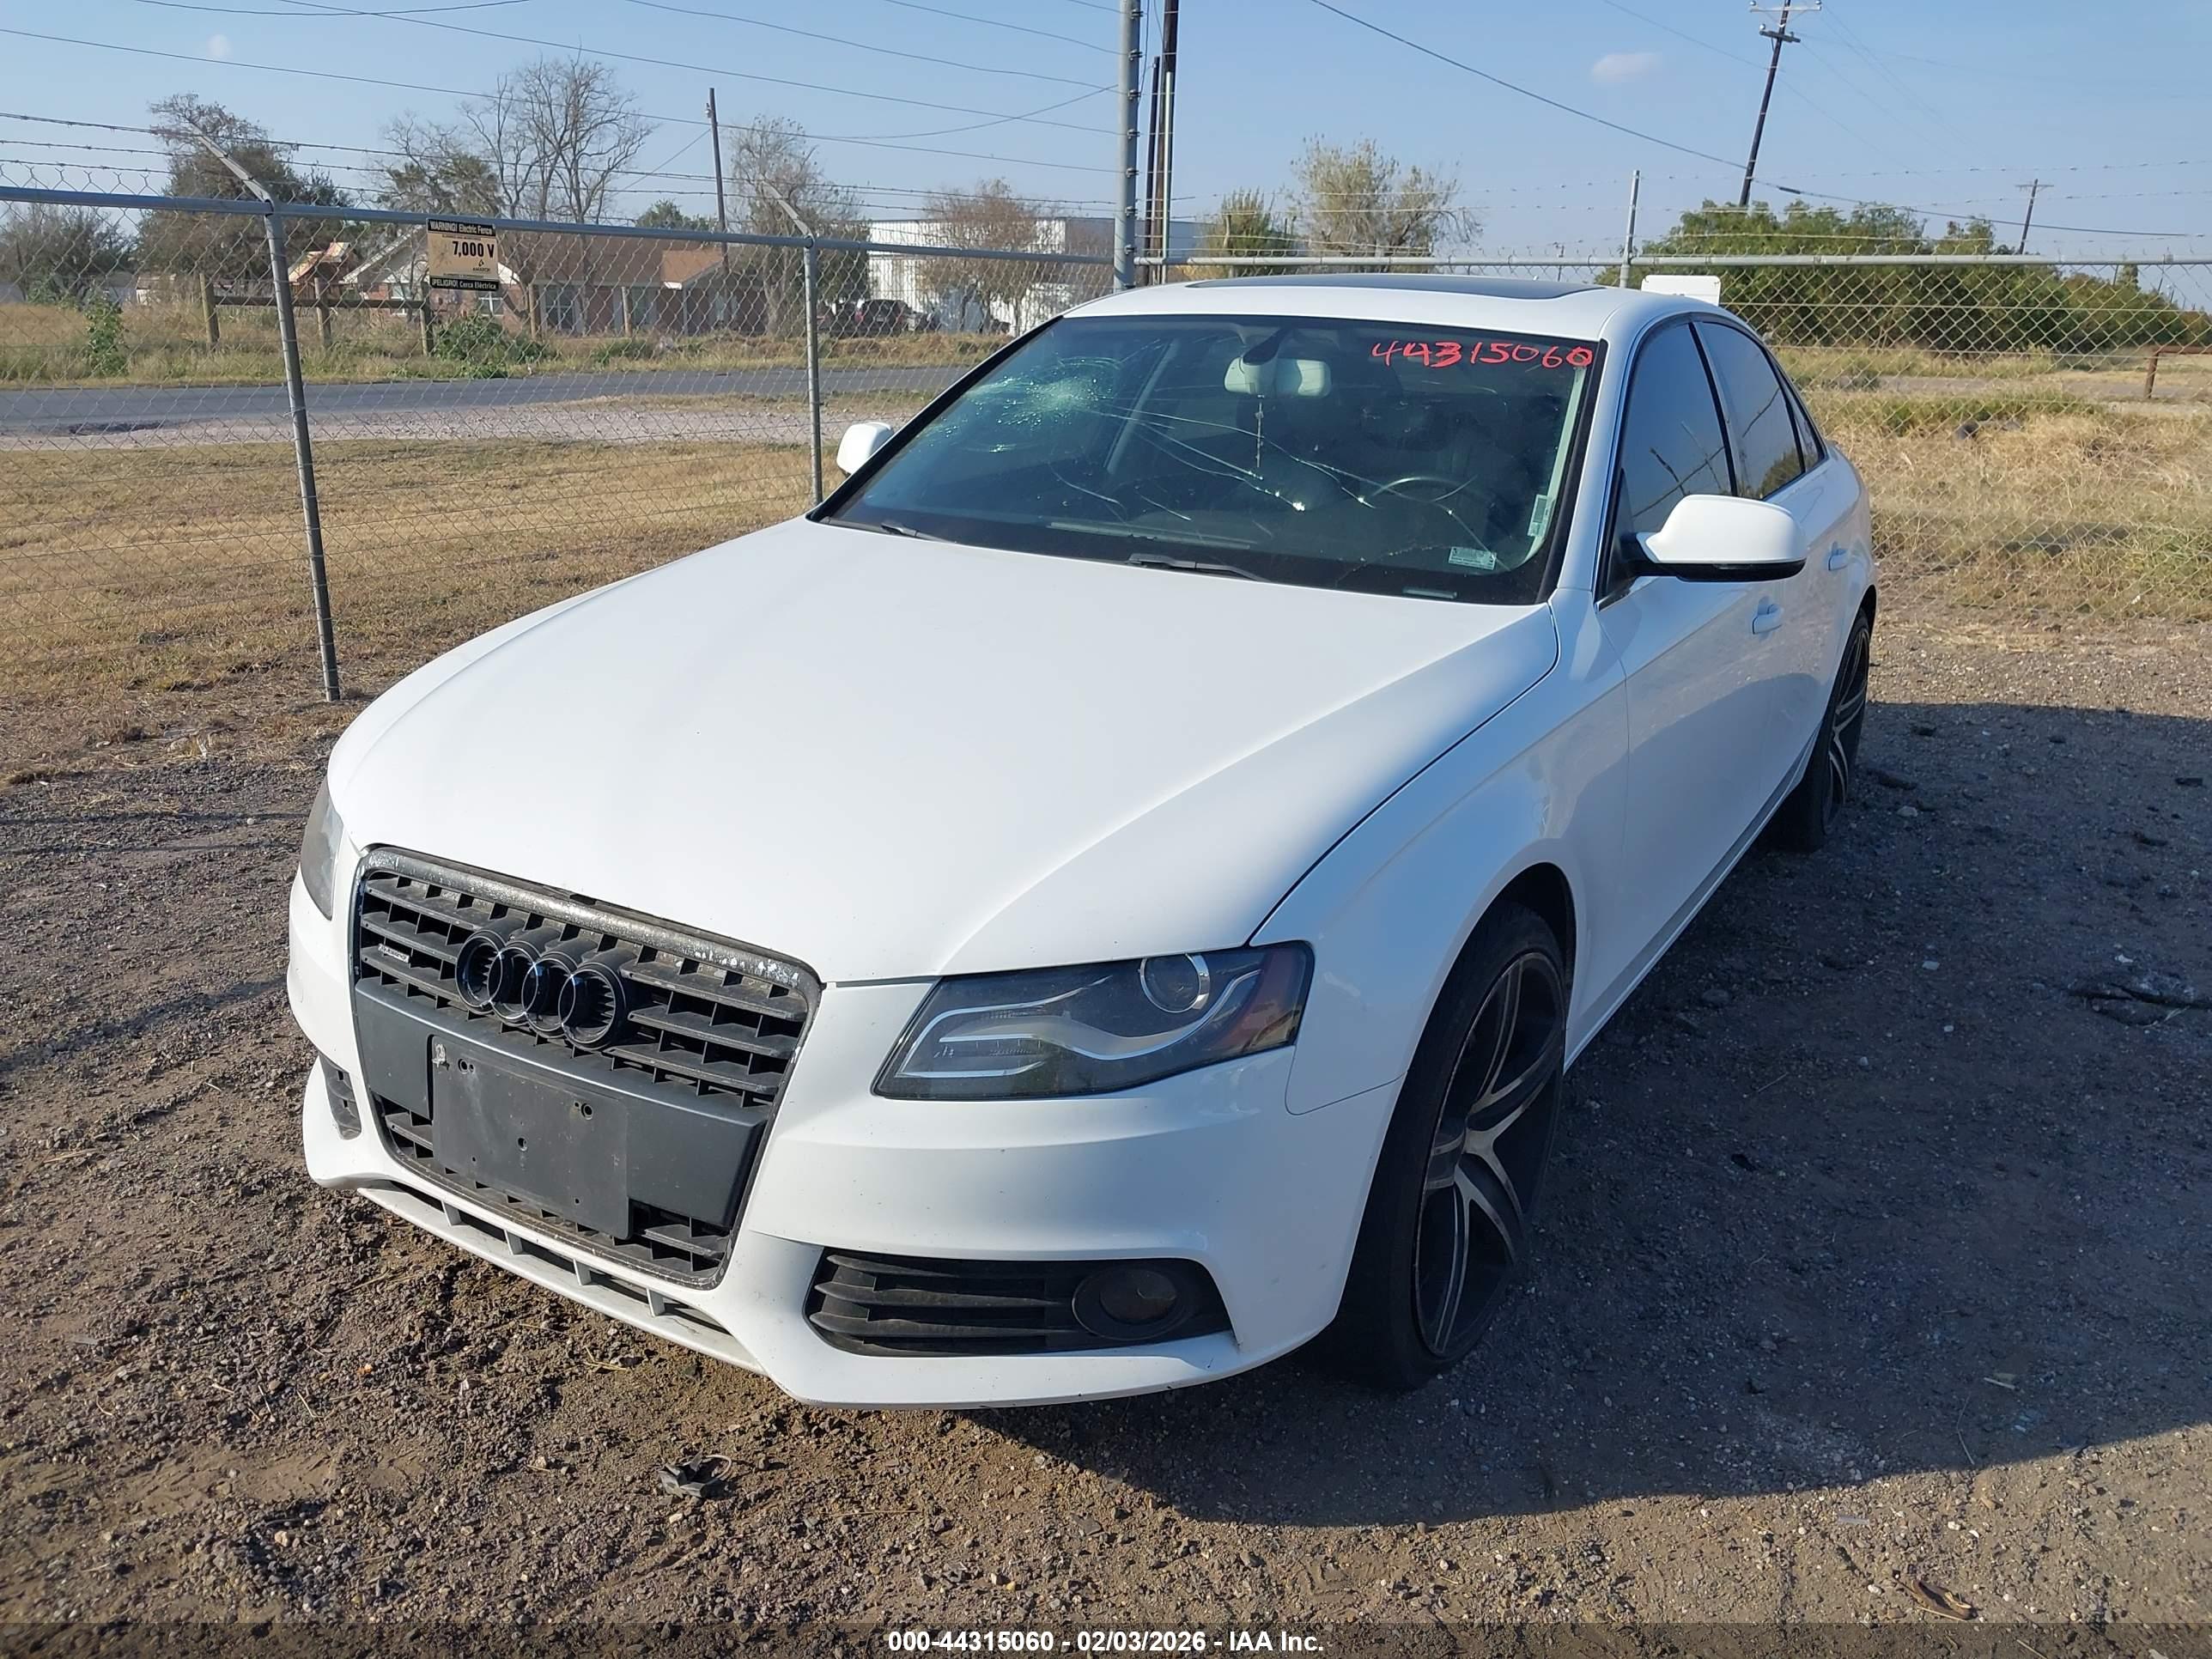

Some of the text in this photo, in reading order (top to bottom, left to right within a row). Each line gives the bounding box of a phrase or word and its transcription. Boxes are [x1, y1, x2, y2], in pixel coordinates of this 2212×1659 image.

[430, 222, 492, 234] WARNING! Electric Fence
[453, 240, 495, 258] 7,000 V
[1371, 340, 1594, 368] 44315060
